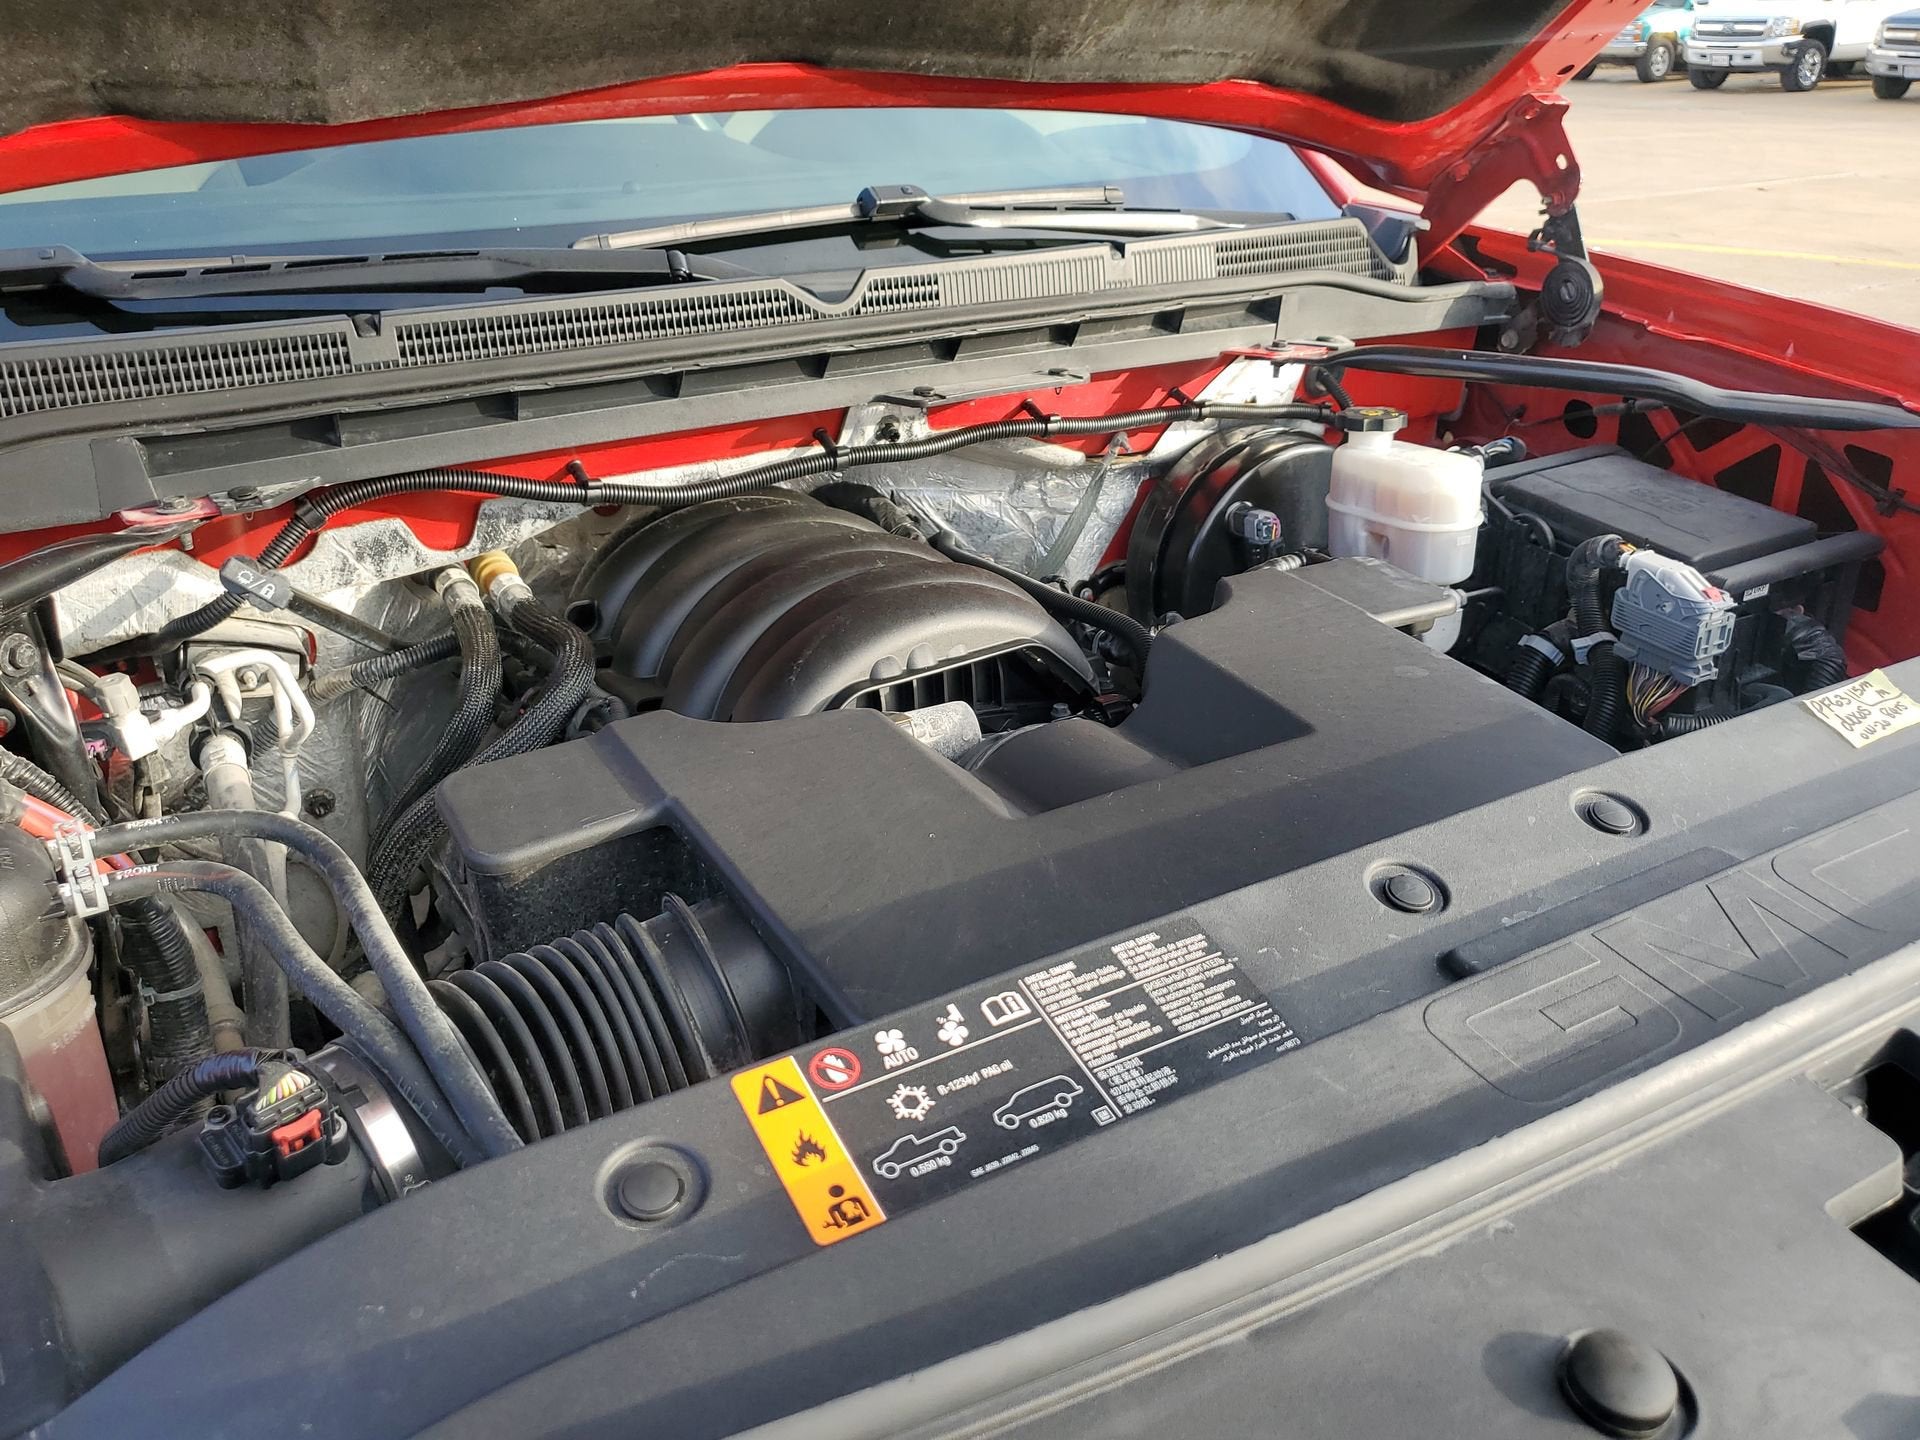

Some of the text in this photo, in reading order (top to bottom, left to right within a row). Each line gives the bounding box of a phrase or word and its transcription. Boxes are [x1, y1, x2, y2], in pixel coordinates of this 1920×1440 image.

[116, 864, 160, 880] FRONT
[883, 1047, 919, 1070] AUTO
[980, 1063, 1002, 1079] PAG
[1000, 1059, 1013, 1073] oil
[1052, 1108, 1068, 1119] kg
[910, 1155, 952, 1177] 0.550 kg
